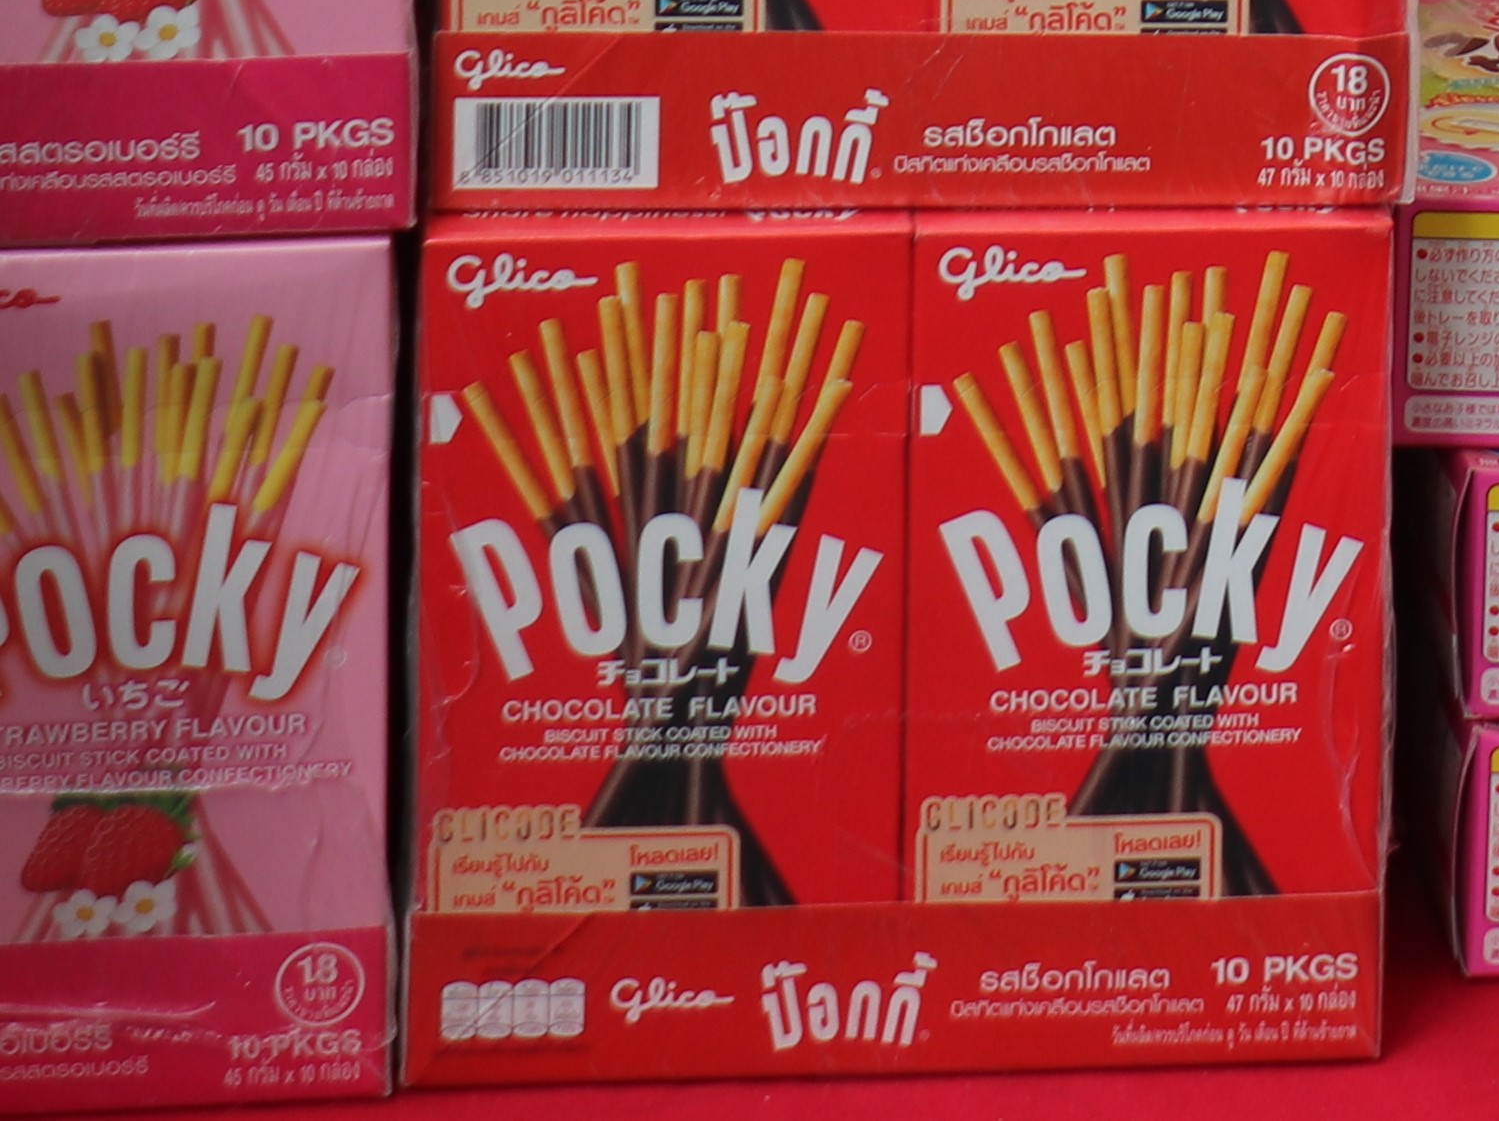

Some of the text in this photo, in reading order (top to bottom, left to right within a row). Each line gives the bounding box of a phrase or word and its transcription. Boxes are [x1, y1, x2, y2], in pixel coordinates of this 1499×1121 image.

[452, 49, 565, 91] Glico
[1330, 65, 1368, 95] 18
[238, 118, 394, 152] 10 PKGS
[923, 116, 1116, 149] รสช็อกโกแลต
[1262, 136, 1385, 165] 10 PKGS
[1257, 168, 1274, 187] 47
[1330, 169, 1345, 187] 10
[445, 254, 598, 309] Glico
[937, 246, 1087, 301] Glico
[597, 657, 740, 688] チョコレート
[1082, 646, 1223, 677] チョコレート
[80, 679, 191, 711] いちご
[502, 694, 817, 723] CHOCOLATE FLAVOUR
[989, 682, 1298, 712] CHOCOLATE FLAVOUR
[980, 959, 1170, 992] รสช็อกโกแลต
[1210, 952, 1358, 985] 10 PKGS
[610, 977, 734, 1024] Glico
